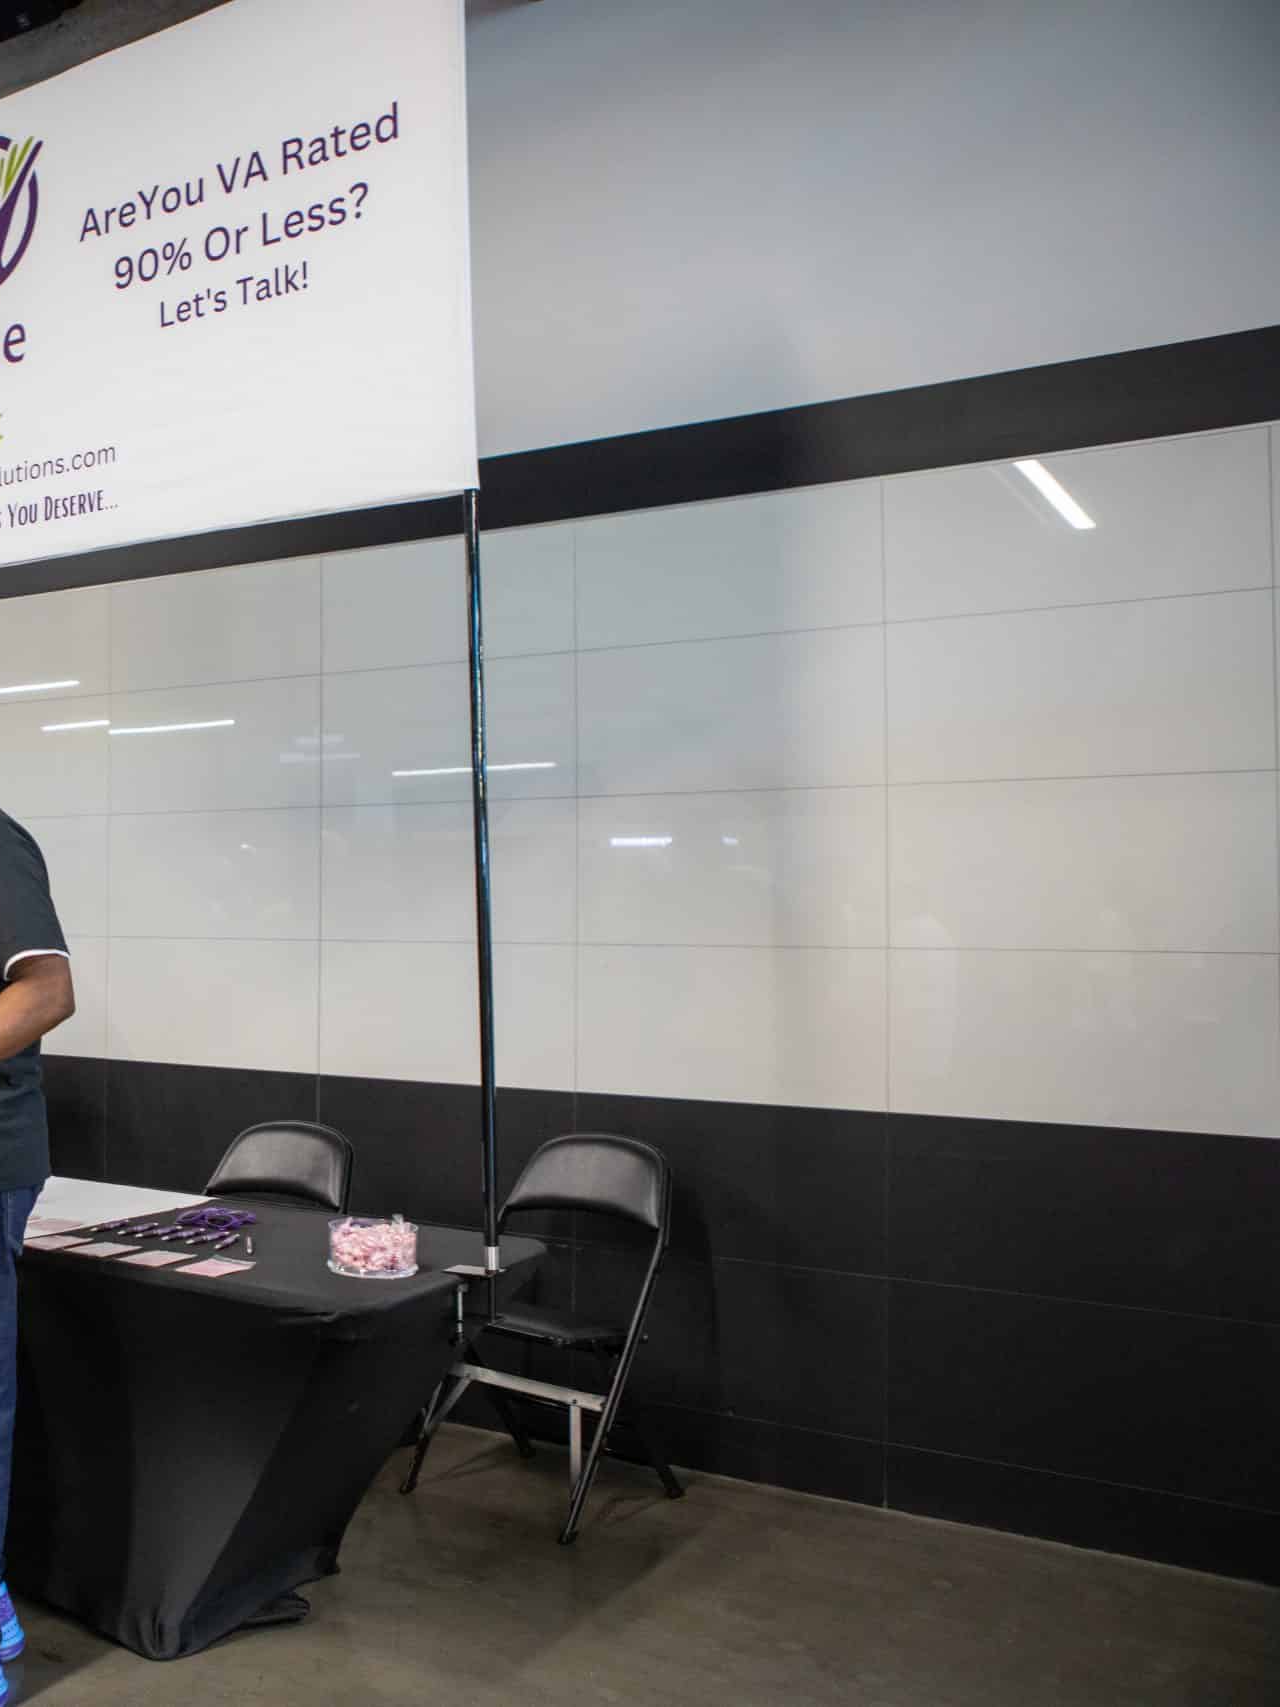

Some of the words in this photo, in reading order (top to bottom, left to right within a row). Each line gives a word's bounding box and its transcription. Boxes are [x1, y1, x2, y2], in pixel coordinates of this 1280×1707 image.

[215, 150, 270, 195] VA
[281, 100, 399, 176] Rated
[114, 237, 193, 291] 90%
[203, 225, 249, 263] Or
[261, 181, 369, 247] Less?
[159, 287, 228, 329] Let's
[235, 260, 309, 306] Talk!
